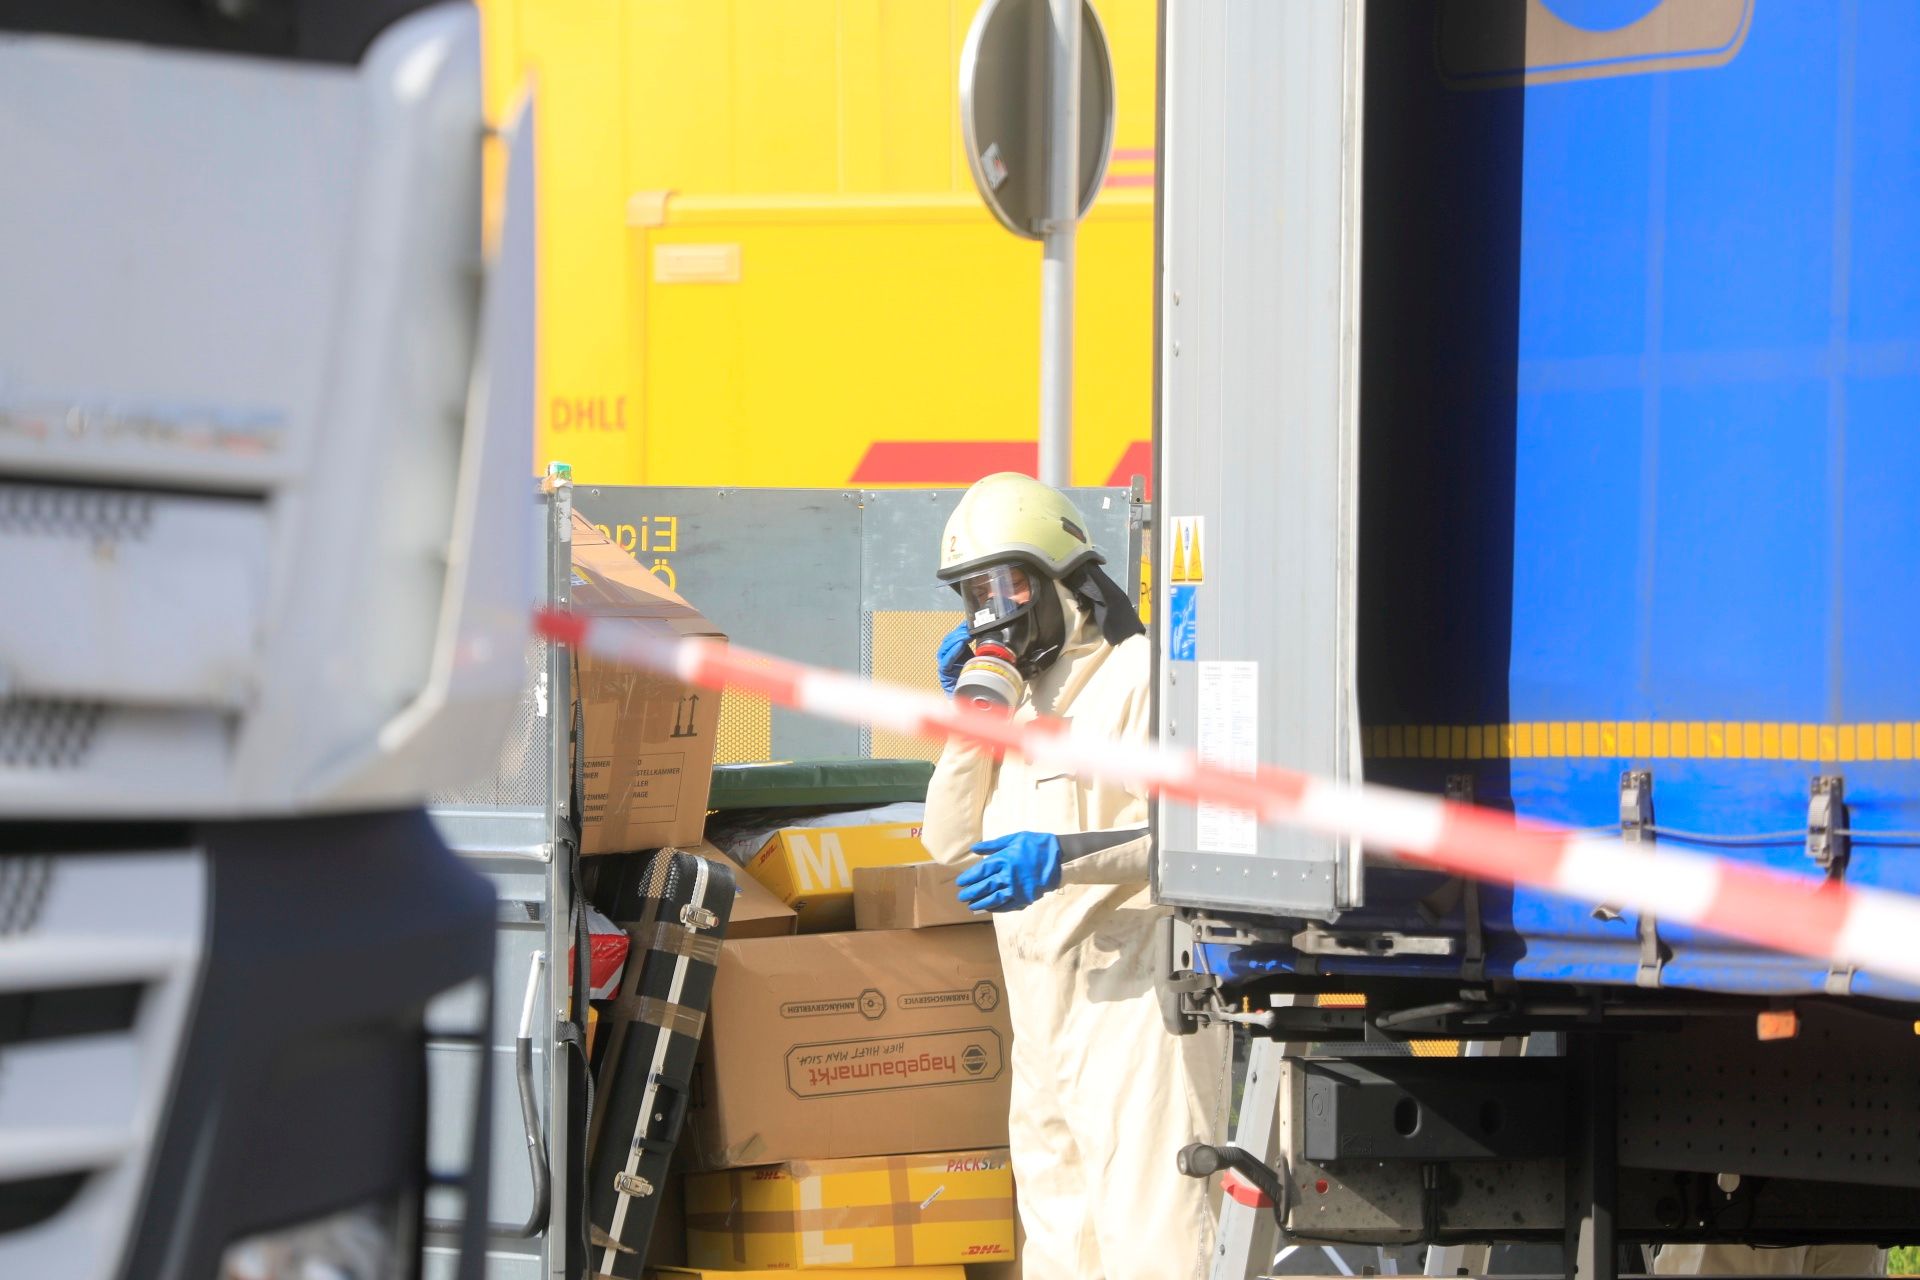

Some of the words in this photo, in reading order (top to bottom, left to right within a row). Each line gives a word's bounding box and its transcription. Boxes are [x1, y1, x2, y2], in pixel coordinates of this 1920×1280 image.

[950, 535, 957, 552] 2
[636, 768, 680, 776] STELLKAMMER
[910, 827, 923, 838] PA
[788, 832, 851, 890] M
[903, 993, 970, 1006] FARBMISCHSERVICE
[787, 1001, 856, 1014] ANHÄNGERVERLEIH
[851, 1045, 881, 1059] HILFT
[883, 1041, 905, 1055] HIER
[825, 1051, 849, 1063] MAN
[808, 1053, 957, 1087] hagebaumarkt
[800, 1174, 854, 1265] L
[968, 1243, 1004, 1256] DHL
